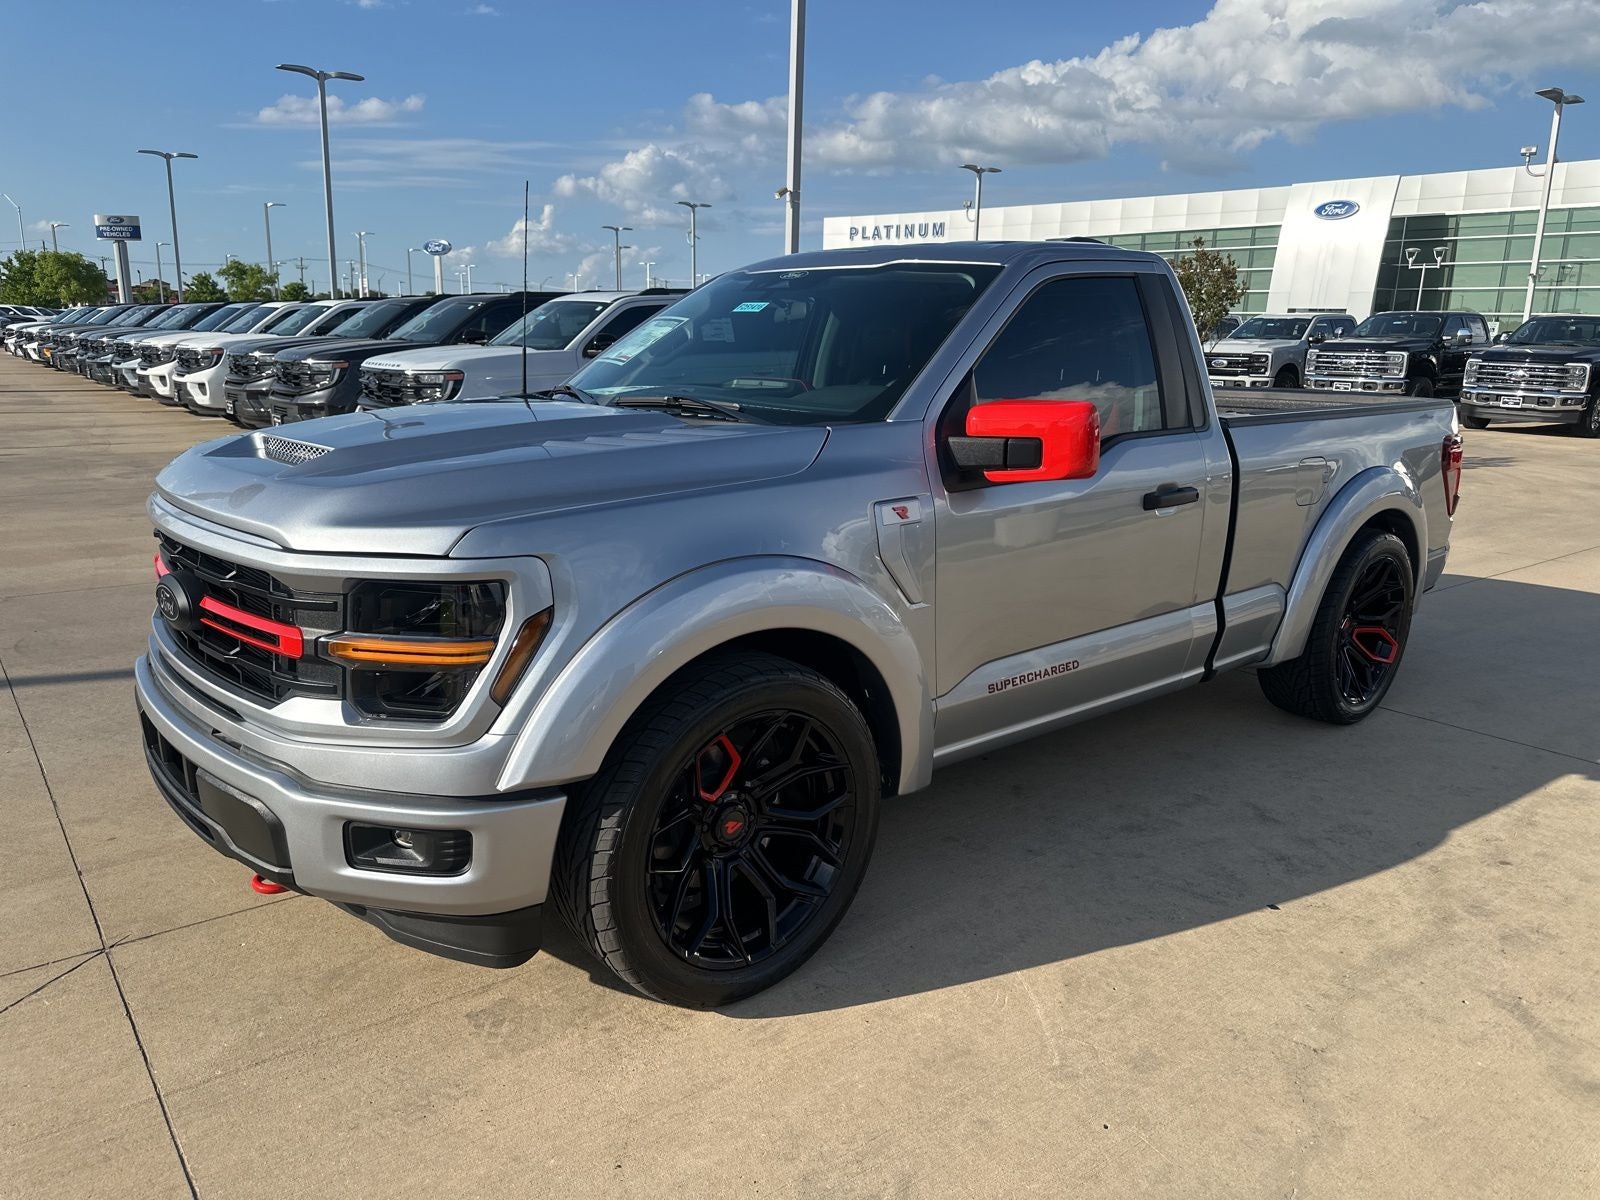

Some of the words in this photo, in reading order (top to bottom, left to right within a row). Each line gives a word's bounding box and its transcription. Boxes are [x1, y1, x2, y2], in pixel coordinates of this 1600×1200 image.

[1321, 203, 1349, 215] Ford
[849, 222, 945, 241] PLATINUM
[160, 588, 174, 616] Ford
[987, 660, 1080, 694] SUPERCHARGED
